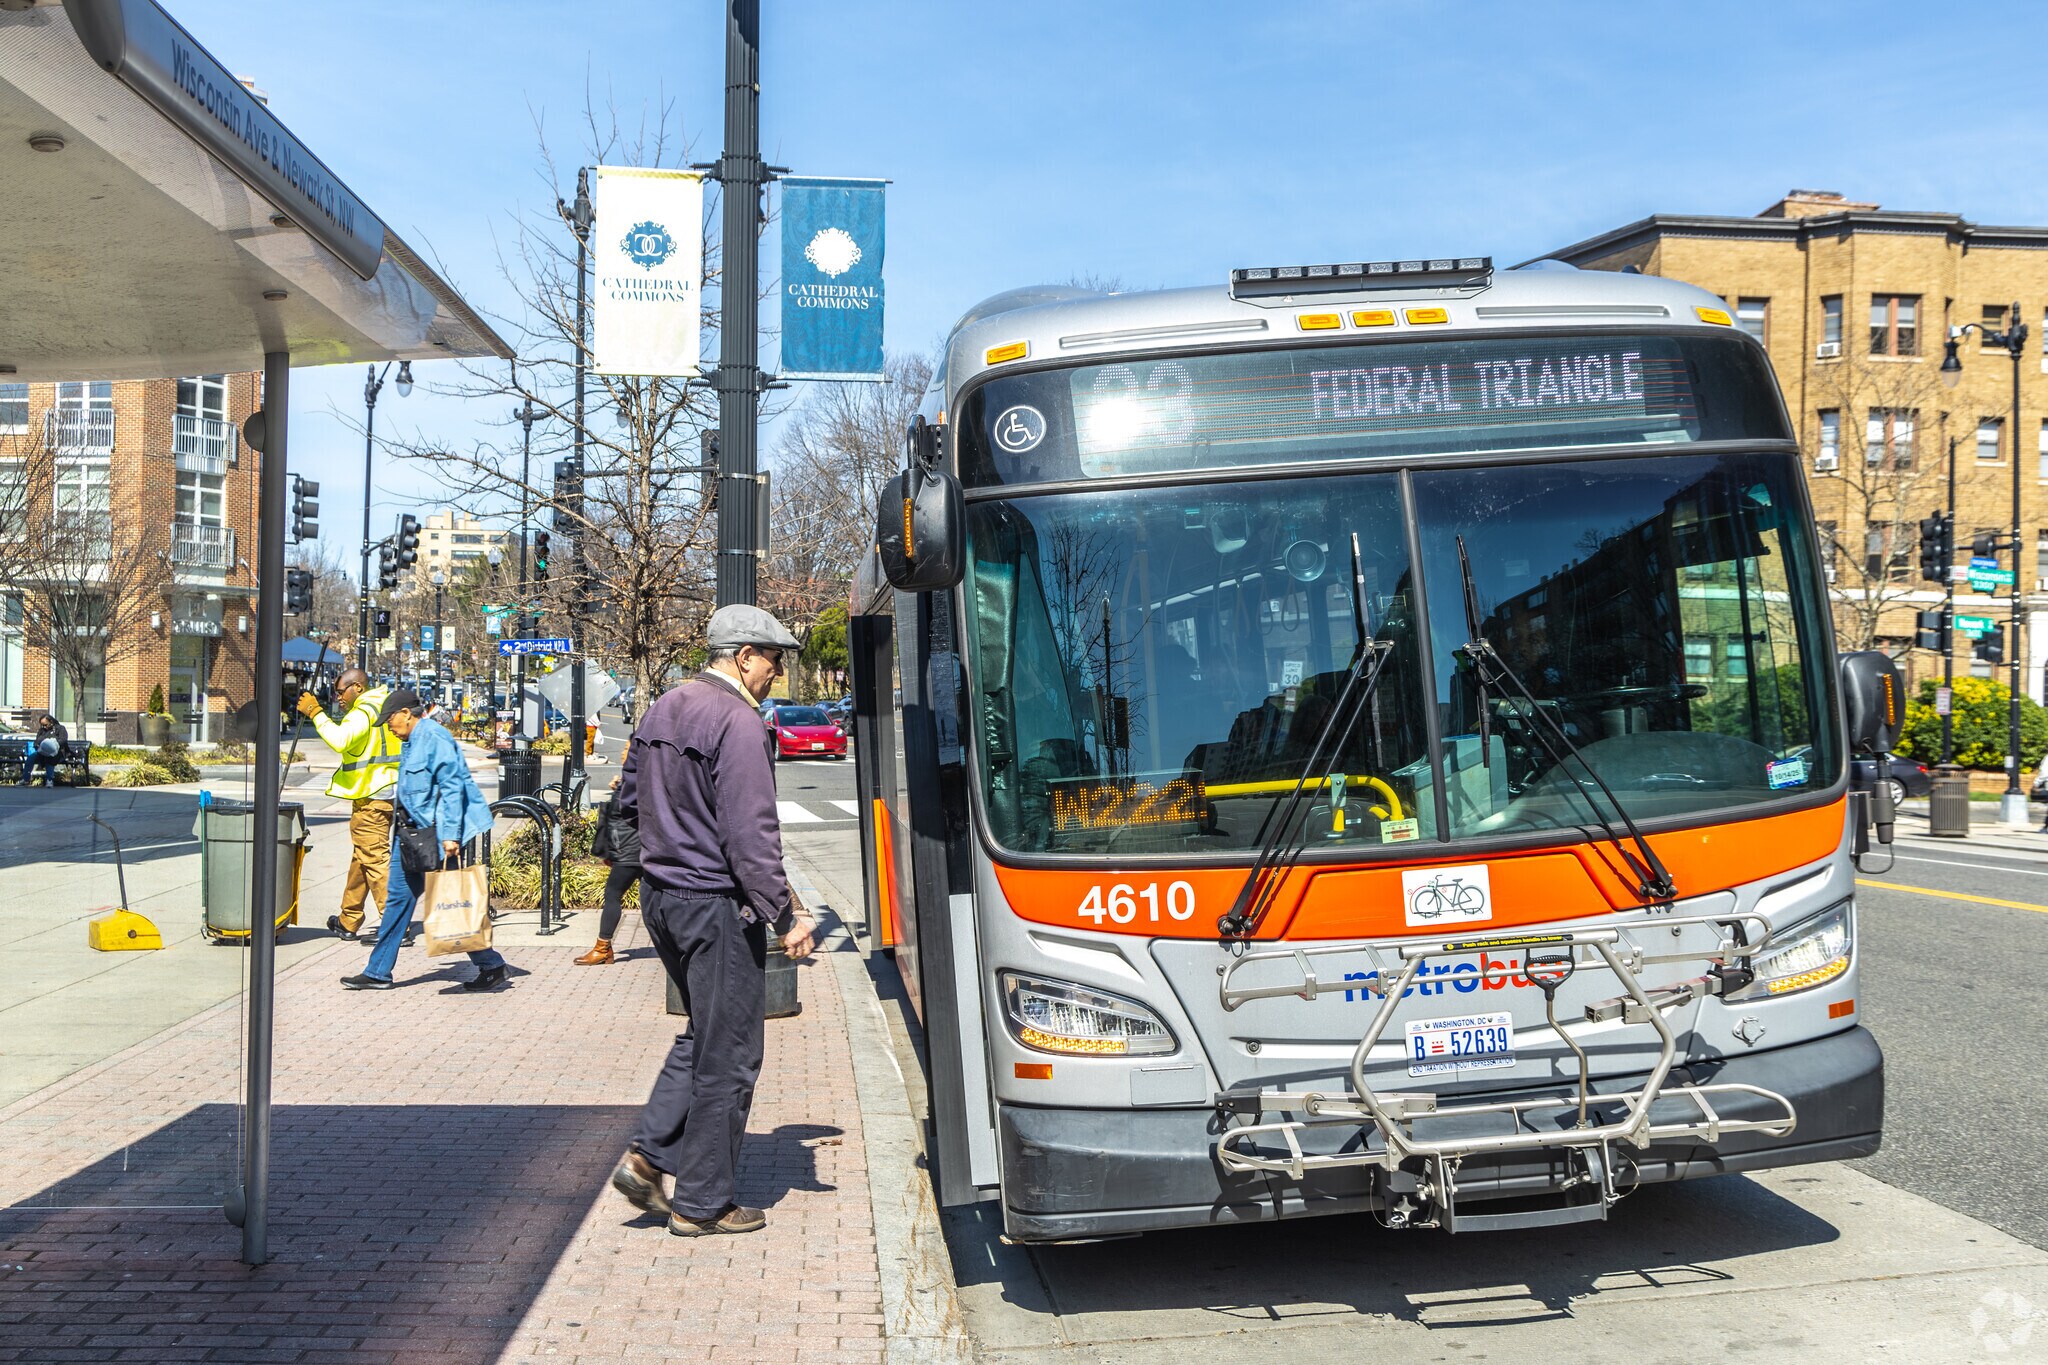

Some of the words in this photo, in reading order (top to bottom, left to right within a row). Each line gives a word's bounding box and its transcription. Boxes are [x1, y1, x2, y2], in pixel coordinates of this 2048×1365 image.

[172, 38, 241, 139] Wisconsin
[244, 109, 268, 162] Ave
[271, 135, 279, 174] &
[283, 142, 323, 211] Newark
[325, 183, 335, 226] St,
[339, 195, 354, 238] NW
[602, 278, 694, 292] CATHEDRAL
[788, 283, 879, 298] CATHEDRAL
[611, 290, 685, 303] COMMONS
[797, 296, 869, 310] COMMONS
[1311, 364, 1461, 418] FEDERAL
[1474, 352, 1644, 409] TRIANGLE
[1077, 880, 1196, 925] 4610
[1477, 1017, 1487, 1025] DC
[1414, 1035, 1426, 1061] B
[1450, 1027, 1508, 1057] 52639
